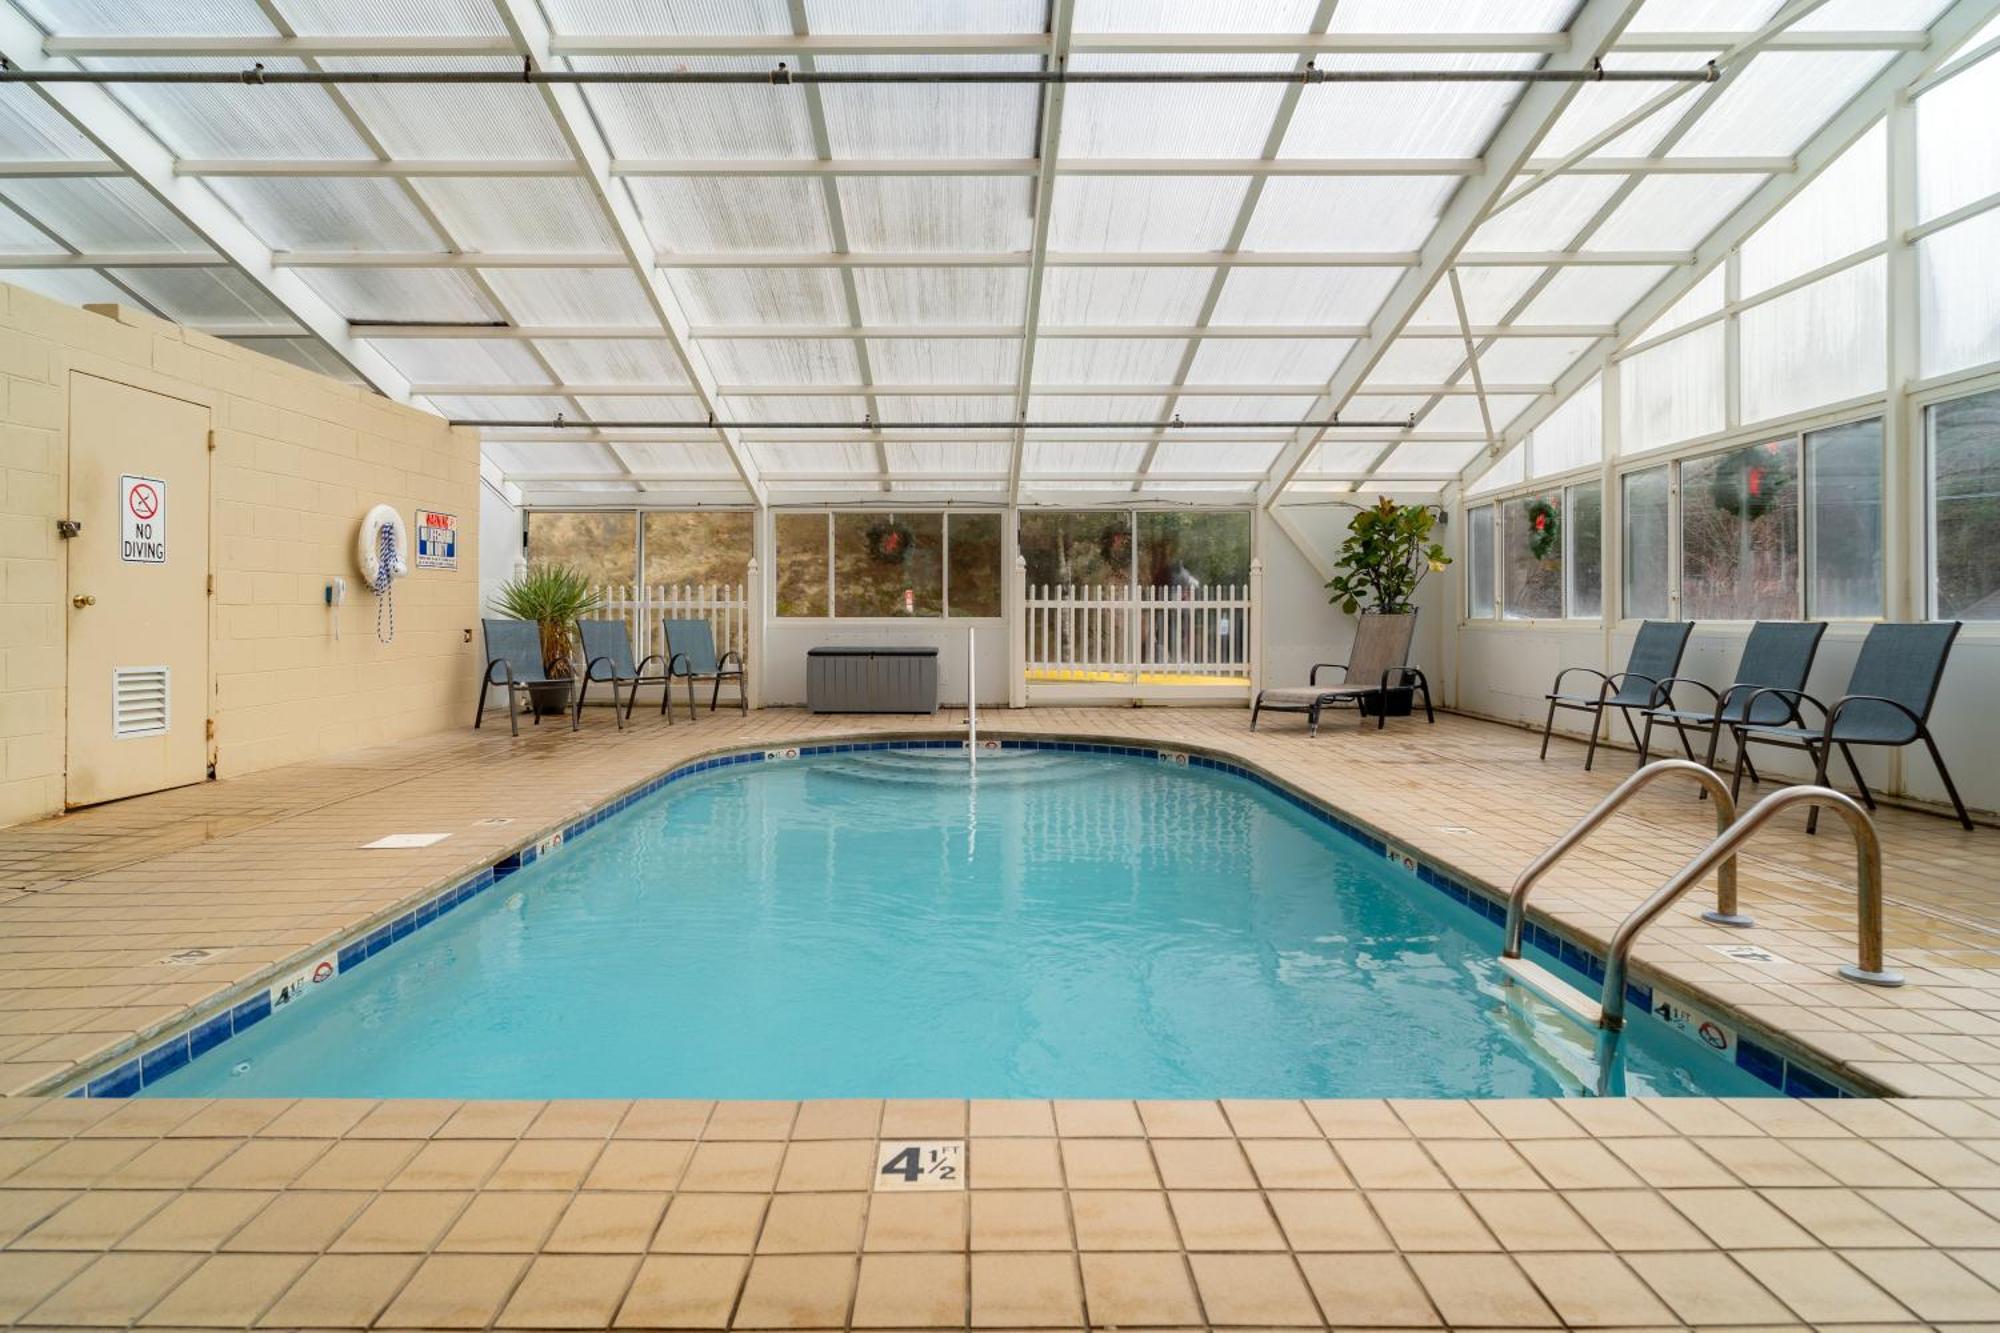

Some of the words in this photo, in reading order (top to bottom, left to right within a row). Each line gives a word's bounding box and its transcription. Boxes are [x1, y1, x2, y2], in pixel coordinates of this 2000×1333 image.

[136, 523, 152, 540] NO
[125, 541, 164, 560] DIVING
[274, 986, 290, 1007] 4
[1654, 1002, 1671, 1021] 4
[881, 1147, 925, 1182] 4
[942, 1146, 960, 1154] FT
